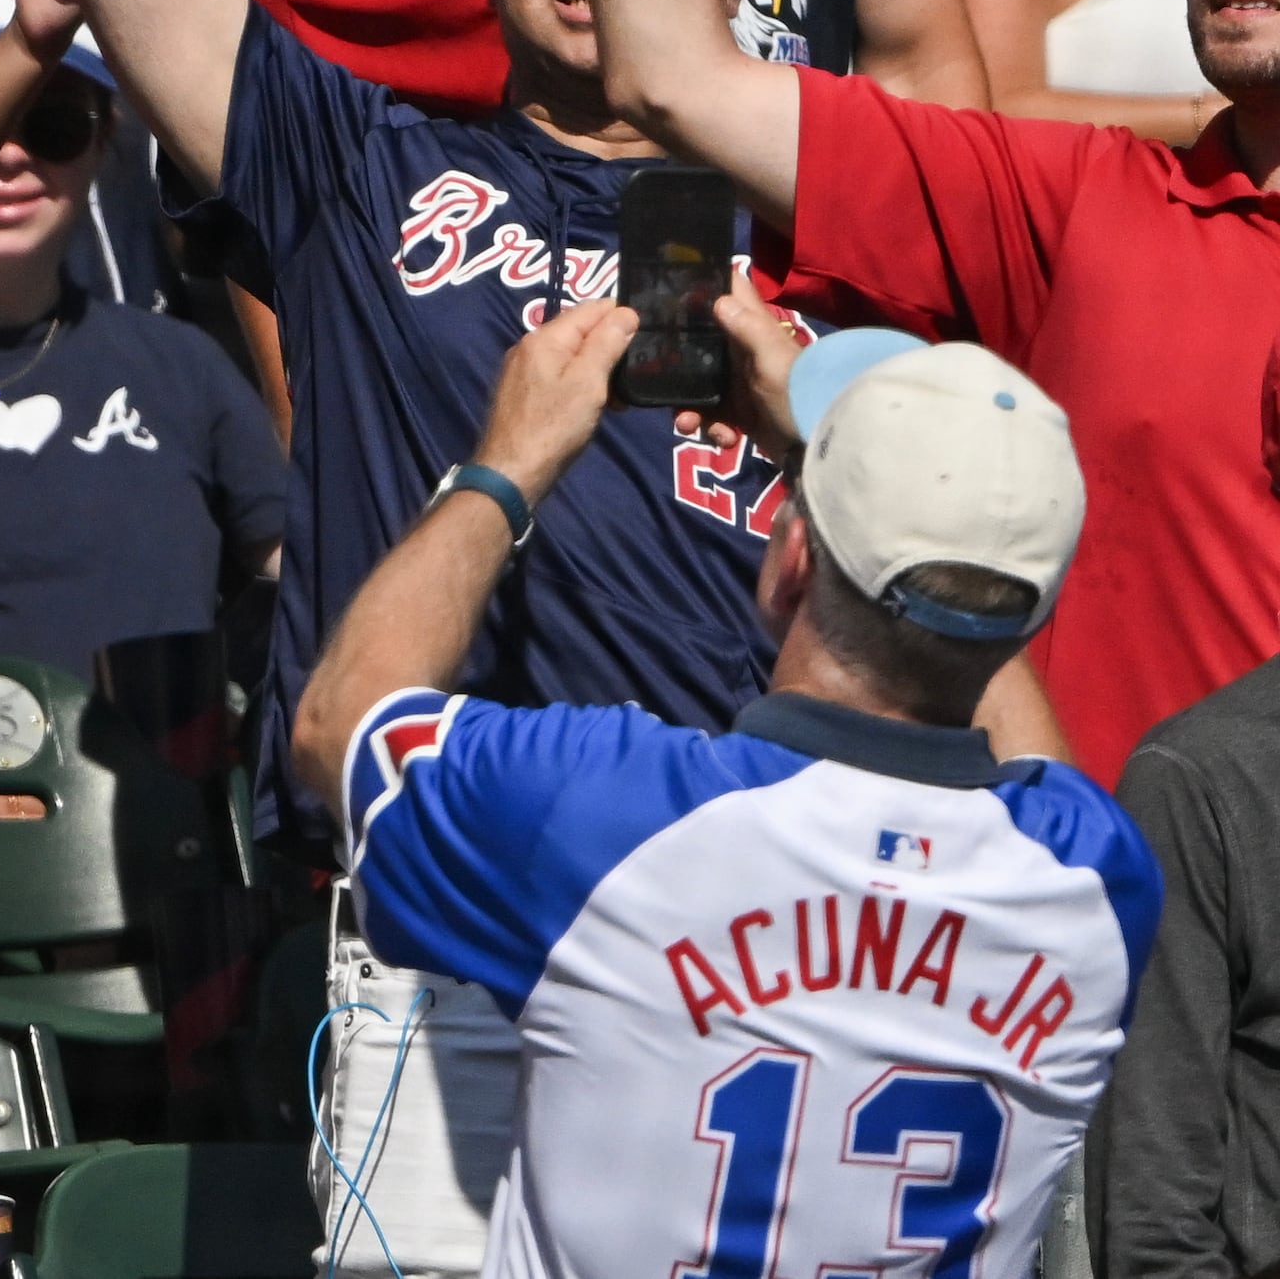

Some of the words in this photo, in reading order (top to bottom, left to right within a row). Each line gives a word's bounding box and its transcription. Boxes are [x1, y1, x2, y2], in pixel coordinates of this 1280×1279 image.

[71, 385, 160, 454] A
[664, 880, 968, 1038] ACUÑA
[670, 1046, 1016, 1279] 13
